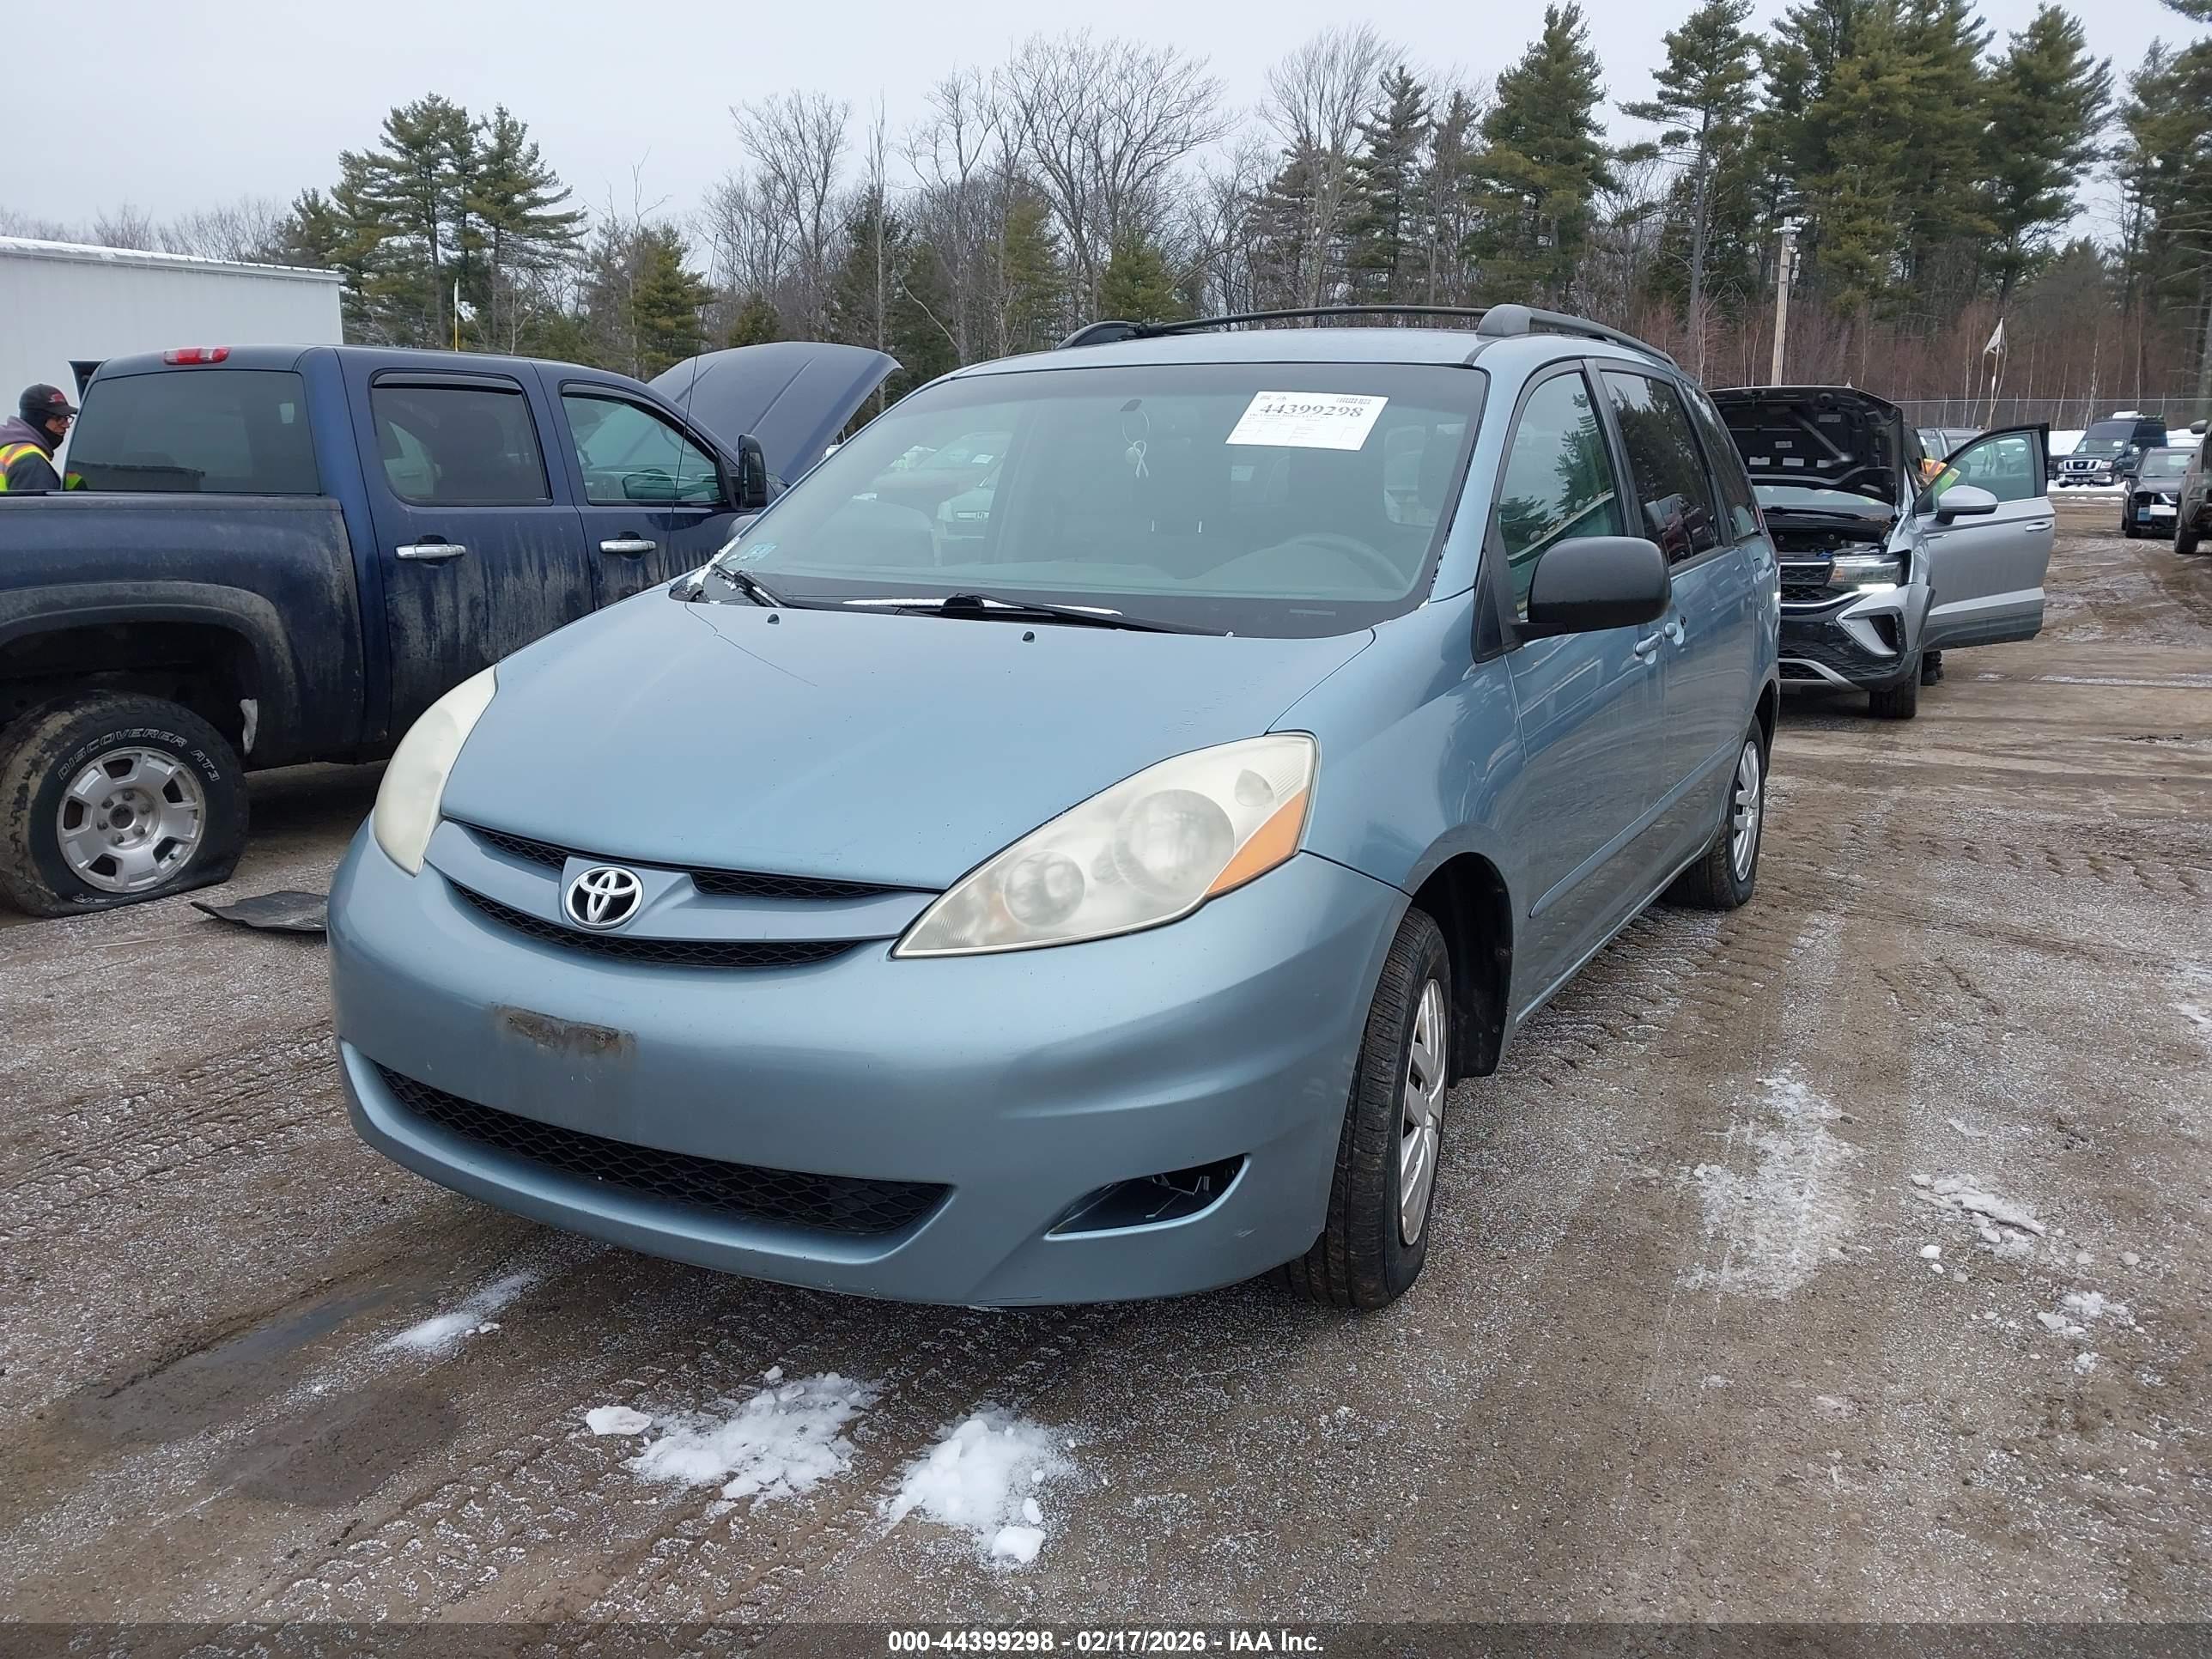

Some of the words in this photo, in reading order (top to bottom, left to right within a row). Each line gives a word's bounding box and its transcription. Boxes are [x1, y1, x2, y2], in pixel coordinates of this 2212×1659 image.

[1260, 404, 1364, 417] 44399298
[58, 727, 187, 781] DISCOVERER
[190, 748, 221, 782] AT3
